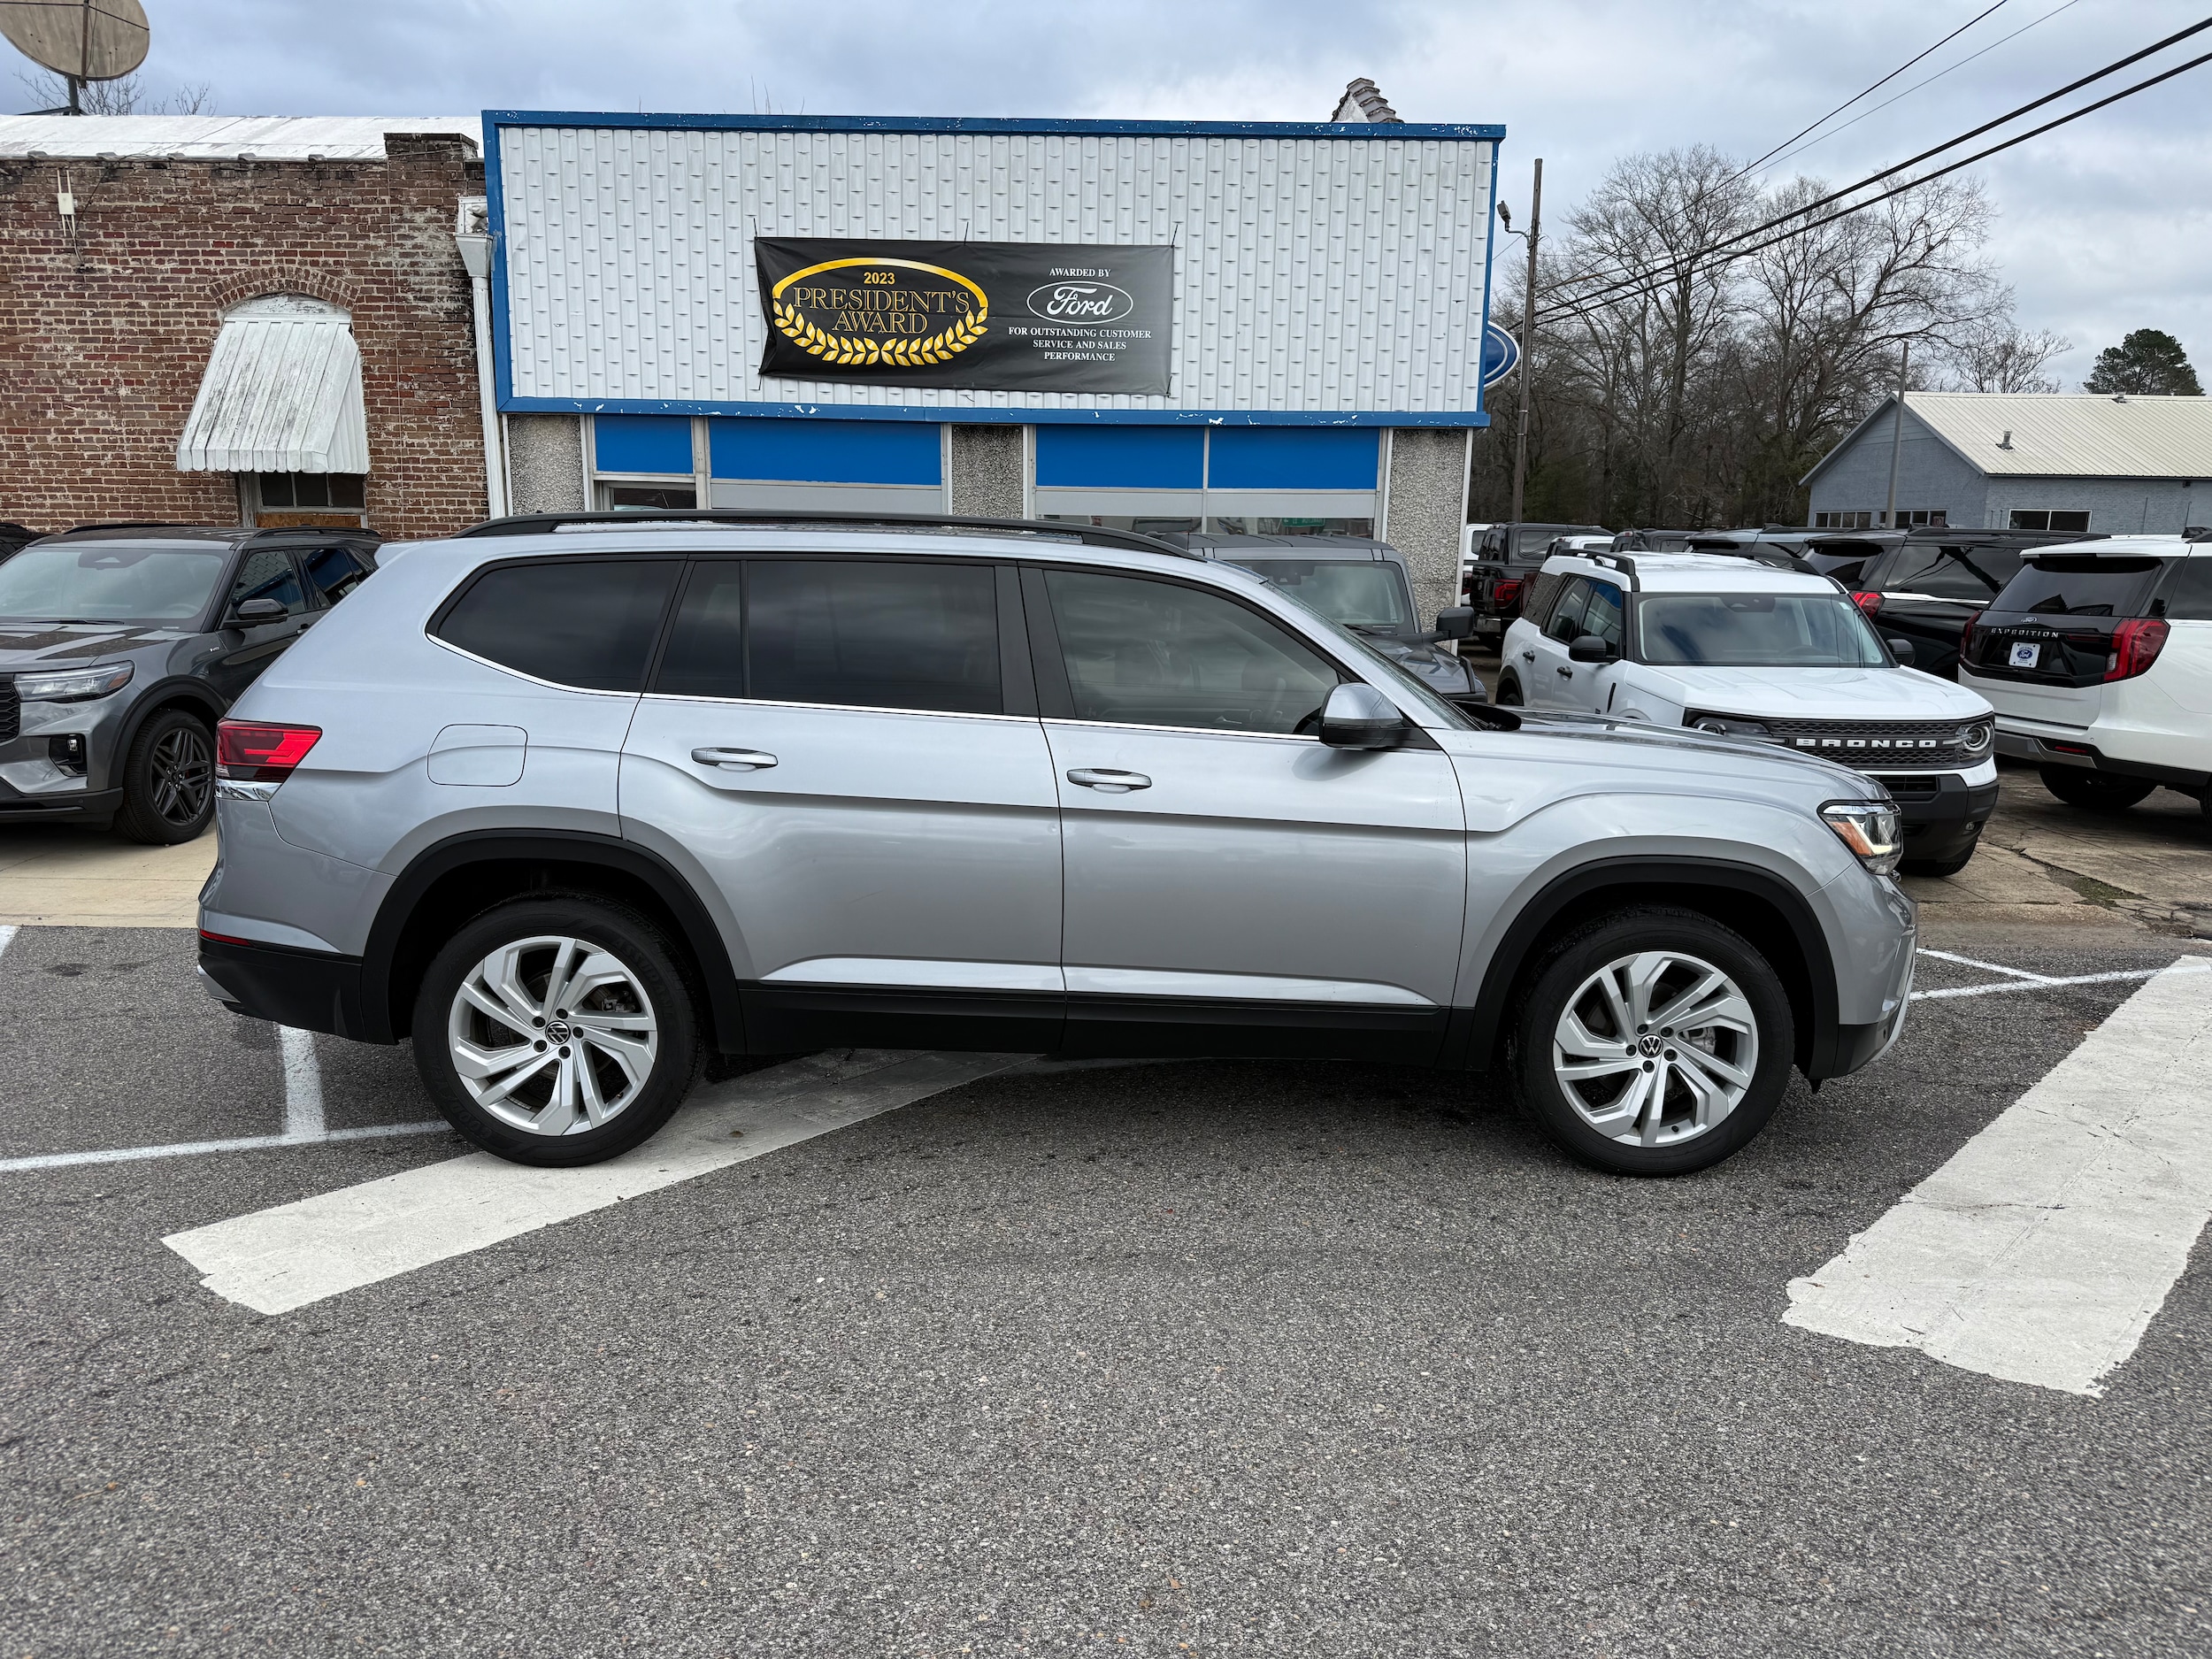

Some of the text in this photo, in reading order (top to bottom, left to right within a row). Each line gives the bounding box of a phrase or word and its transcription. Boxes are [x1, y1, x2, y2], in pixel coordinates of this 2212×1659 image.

[864, 272, 895, 285] 2023
[1049, 267, 1111, 278] AWARDED BY
[793, 287, 971, 314] PRESIDENT'S
[1047, 286, 1114, 316] Ford
[832, 311, 928, 334] AWARD
[1008, 326, 1152, 339] FOR OUTSTANDING CUSTOMER
[1033, 339, 1127, 350] SERVICE AND SALES
[1044, 351, 1116, 362] PERFORMANCE
[1991, 627, 2060, 638] EXPEDITION
[1795, 737, 1937, 749] BRONCO
